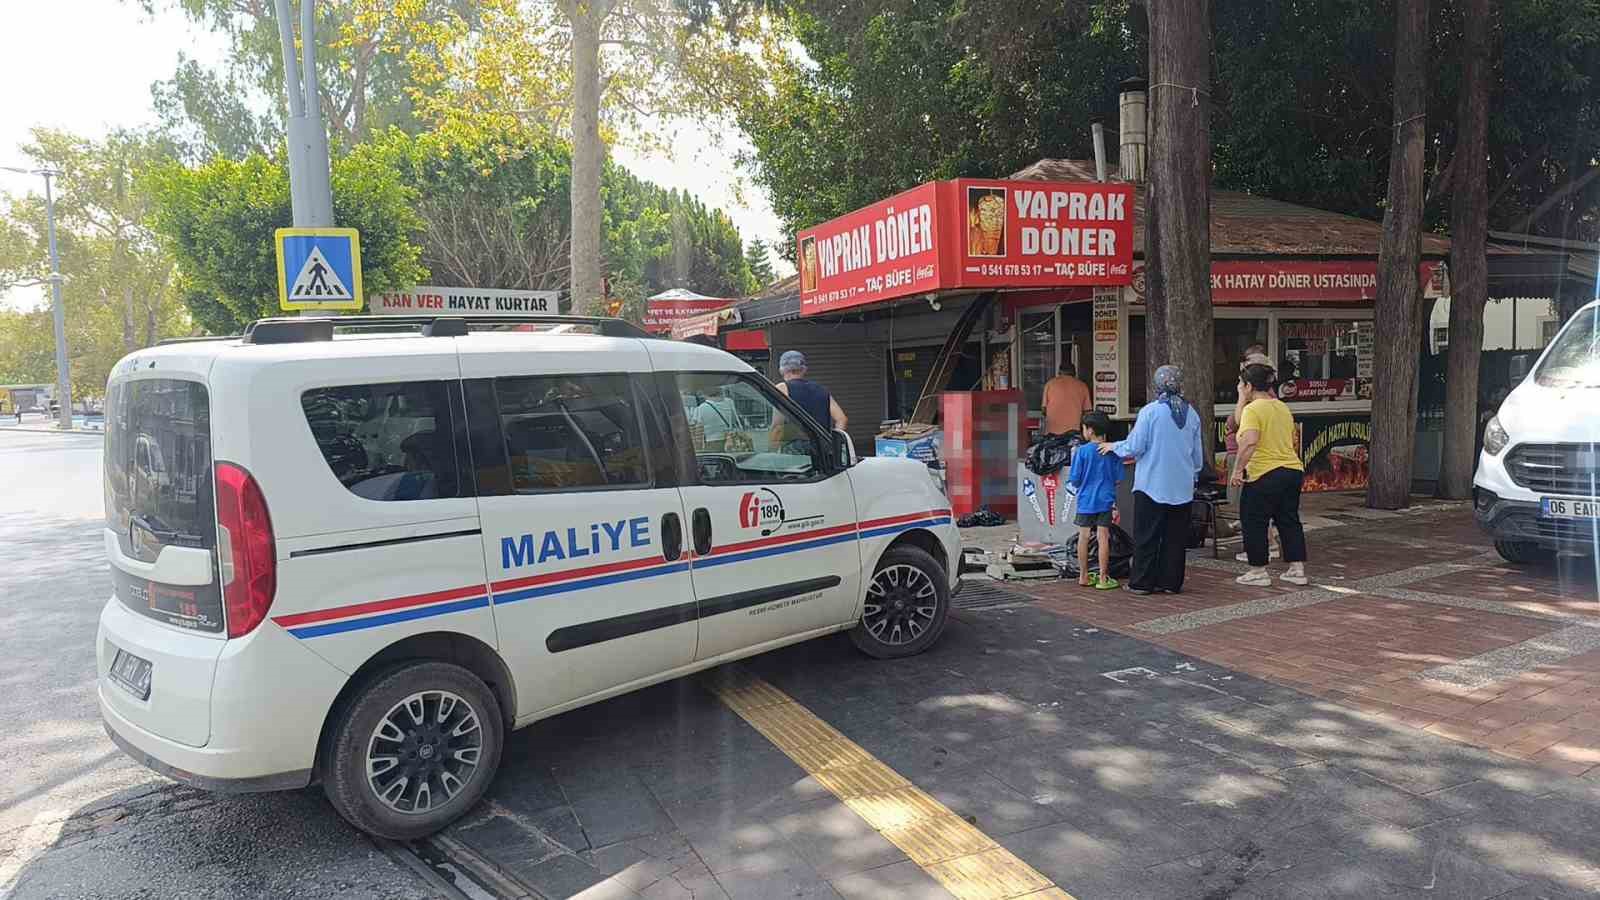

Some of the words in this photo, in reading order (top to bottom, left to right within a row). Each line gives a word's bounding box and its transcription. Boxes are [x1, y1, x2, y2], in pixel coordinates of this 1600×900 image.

[1014, 190, 1126, 221] YAPRAK
[818, 224, 872, 279] YAPRAK
[875, 204, 933, 263] DÖNER
[1021, 222, 1116, 256] DÖNER
[981, 264, 987, 275] 0
[988, 264, 1003, 275] 541
[1005, 264, 1019, 276] 678
[1021, 264, 1031, 276] 53
[1033, 265, 1042, 276] 17
[1055, 262, 1075, 279] TAÇ
[1078, 260, 1105, 277] BÜFE
[818, 293, 828, 304] 541
[840, 289, 848, 300] 53
[849, 287, 857, 297] 17
[866, 276, 883, 293] TAÇ
[885, 267, 912, 289] BÜFE
[1225, 274, 1266, 289] HATAY
[1269, 270, 1311, 289] DÖNER
[383, 294, 412, 309] KAN
[416, 294, 444, 309] VER
[448, 295, 491, 310] HAYAT
[495, 296, 548, 312] KURTAR
[760, 503, 780, 520] 189
[1550, 501, 1566, 514] 06
